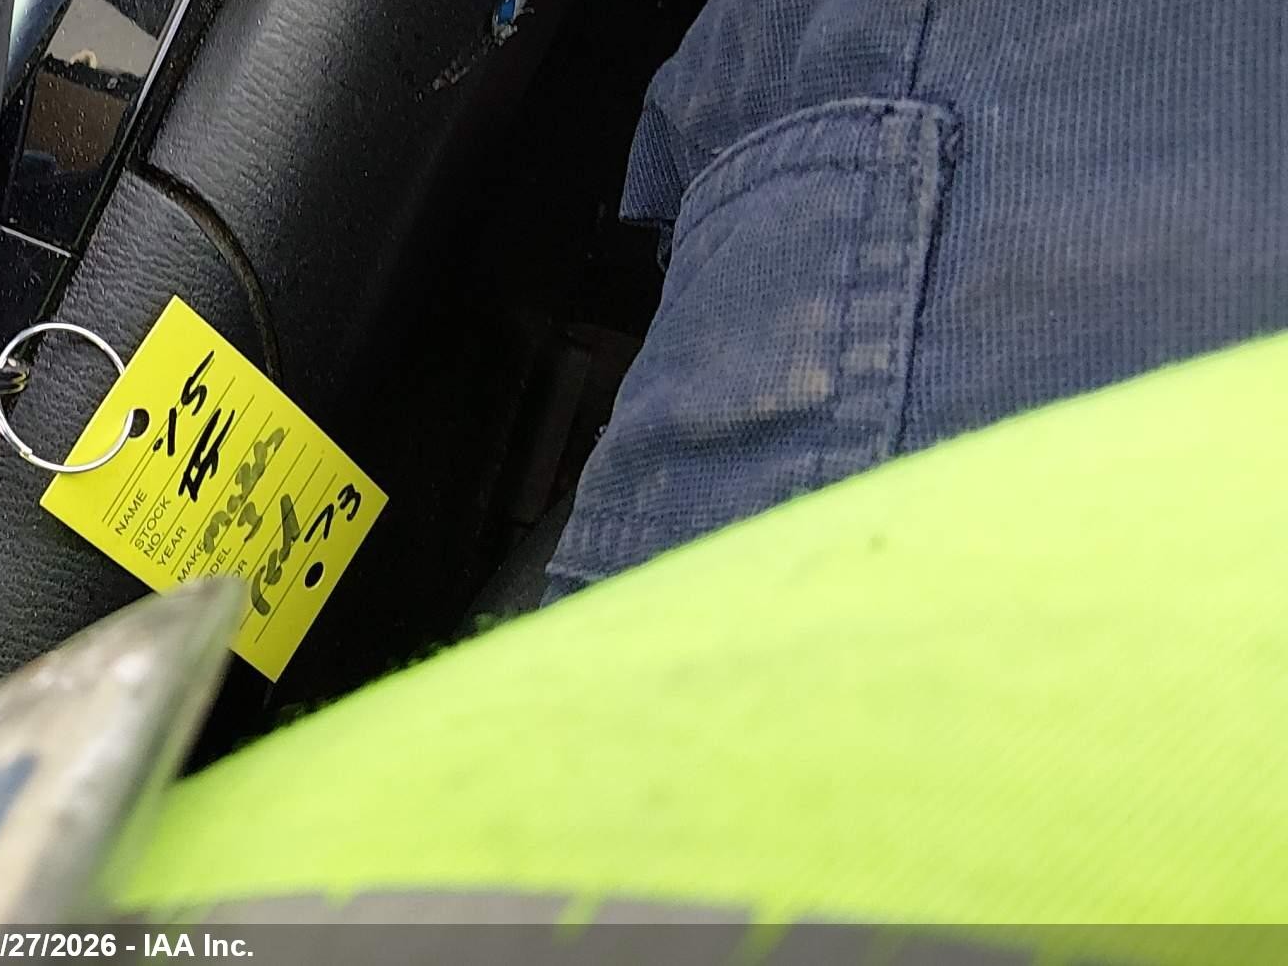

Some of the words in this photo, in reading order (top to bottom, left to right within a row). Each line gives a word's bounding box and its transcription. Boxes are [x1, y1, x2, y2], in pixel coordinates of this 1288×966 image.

[115, 489, 148, 535] NAME
[134, 495, 171, 551] STOCK
[157, 526, 187, 566] YEAR
[177, 539, 206, 583] MAKE
